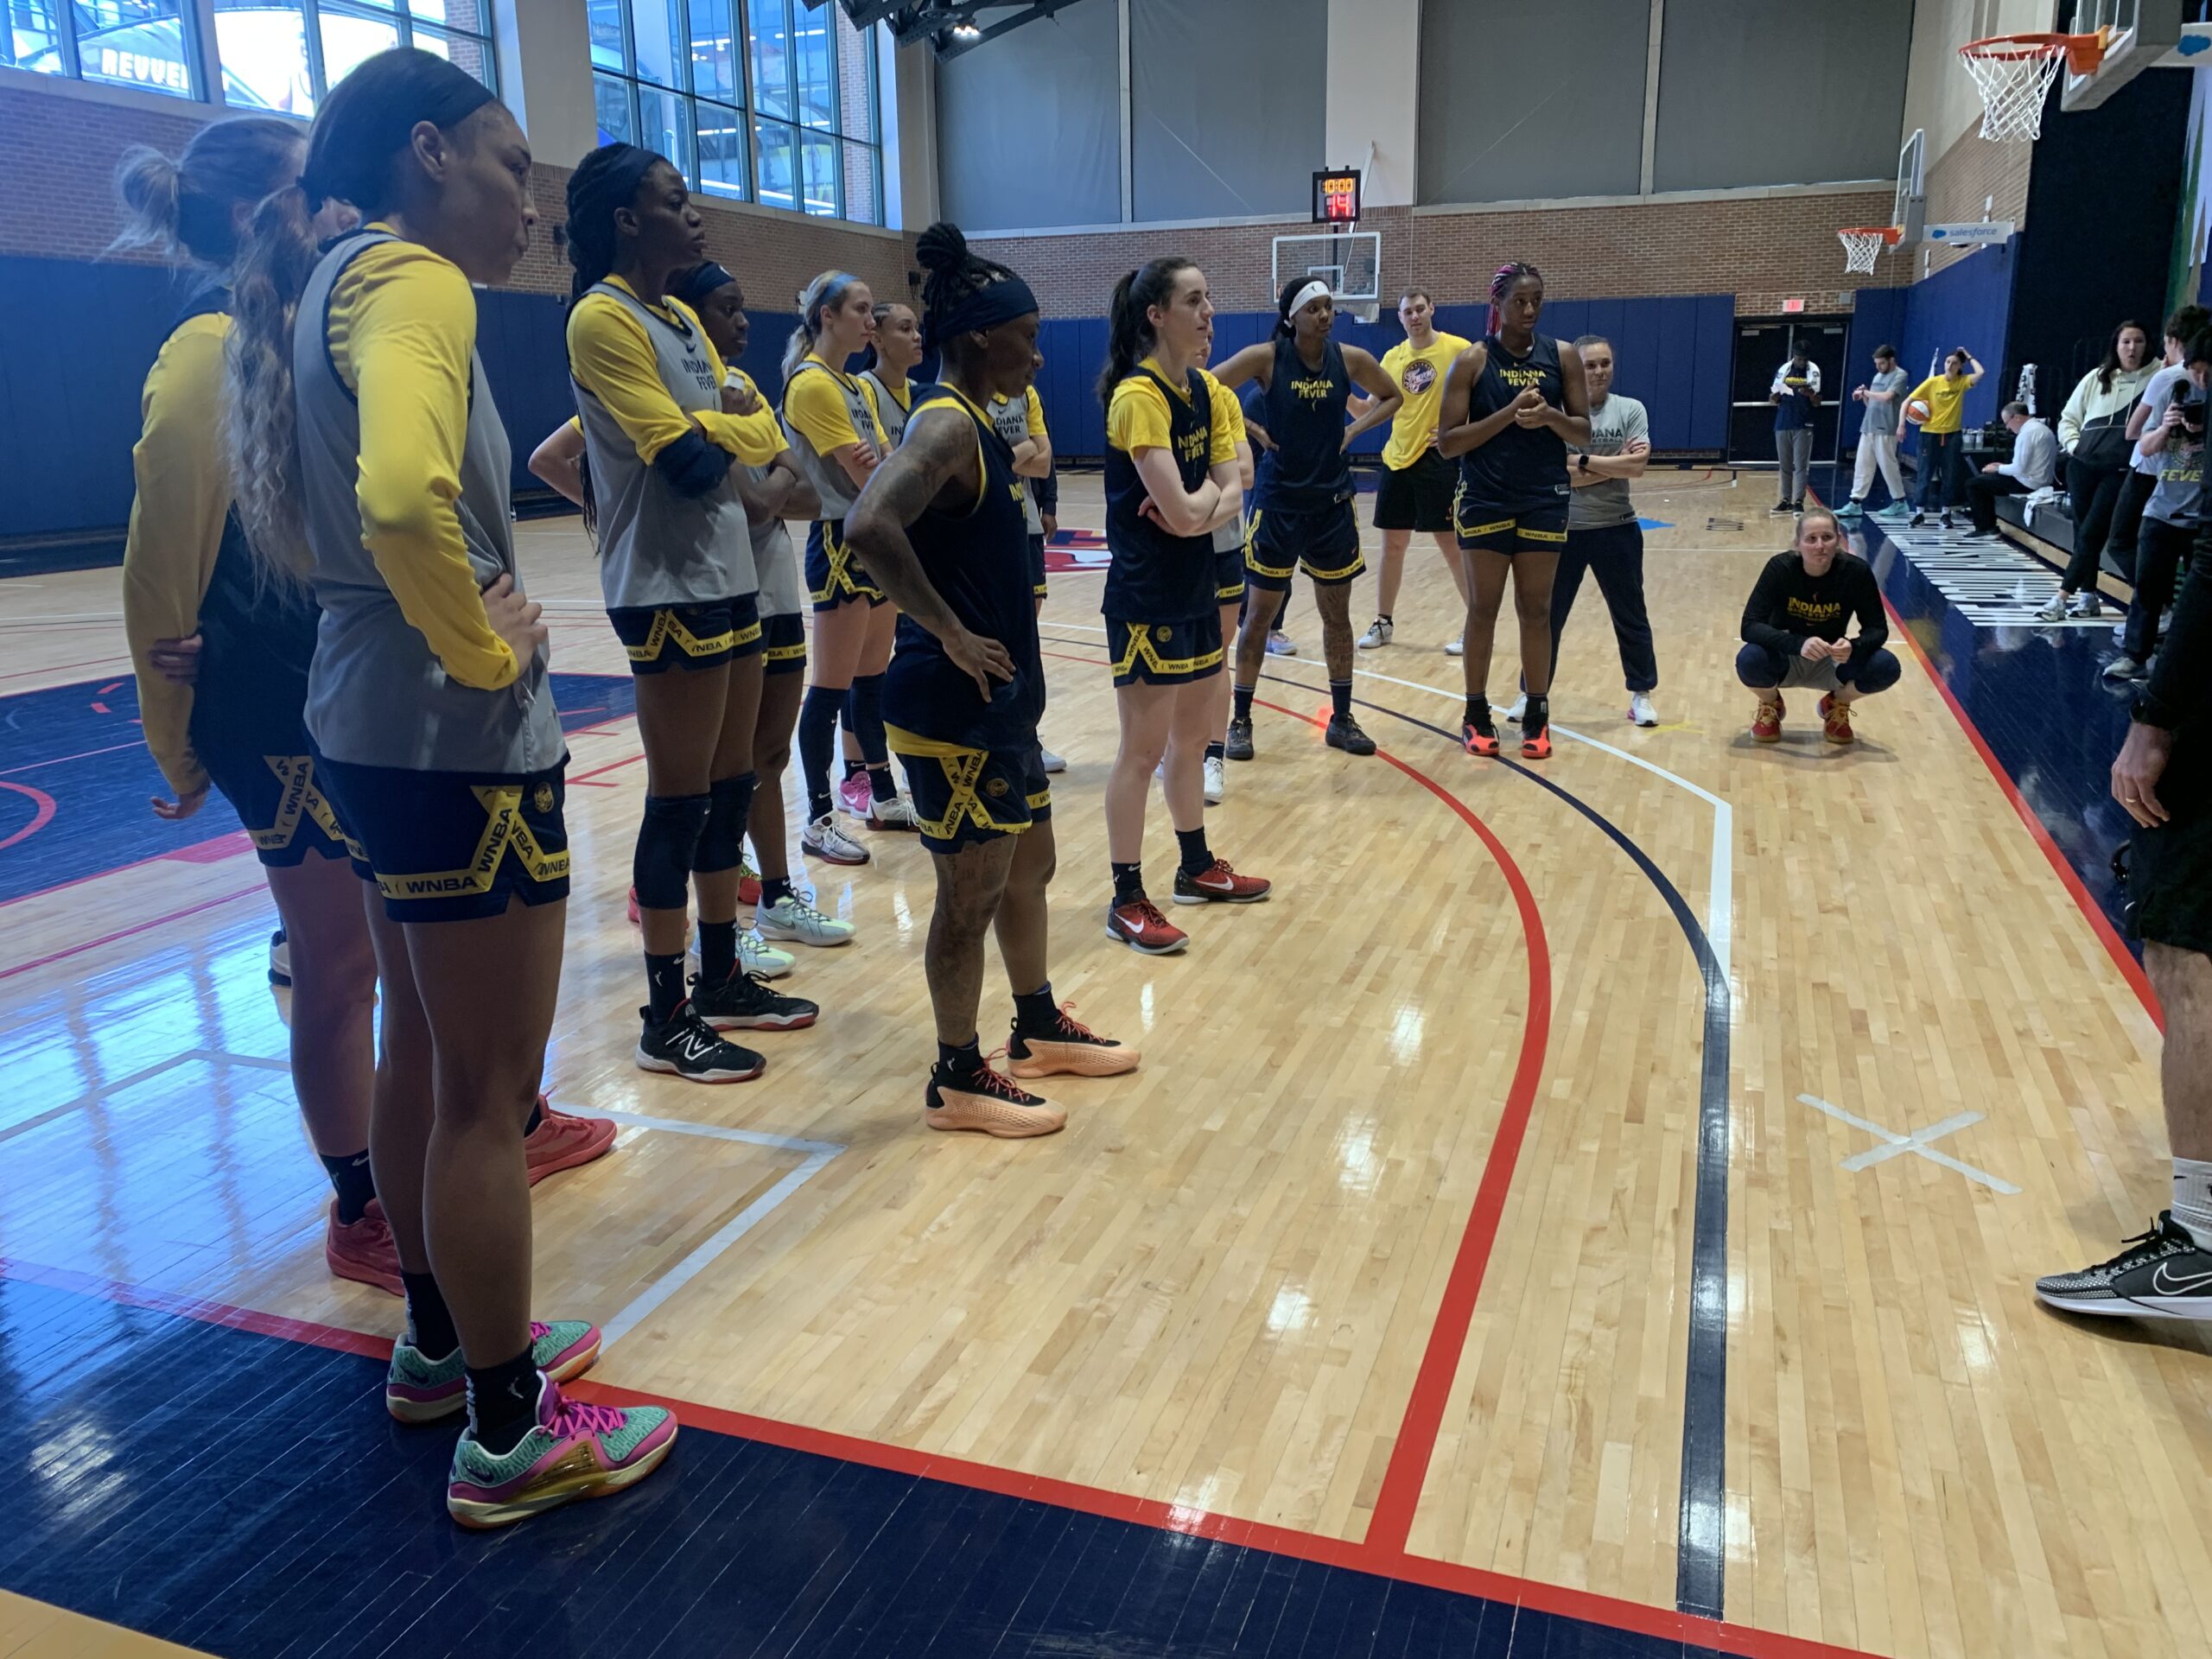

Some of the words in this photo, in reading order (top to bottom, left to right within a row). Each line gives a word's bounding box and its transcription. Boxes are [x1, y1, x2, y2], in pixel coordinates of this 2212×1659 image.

[1332, 194, 1350, 217] 14
[1949, 227, 1998, 238] salesforce
[1500, 369, 1547, 378] INDIANA
[1291, 379, 1333, 390] INDIANA
[1299, 389, 1327, 398] FEVER
[1592, 429, 1624, 437] IANA
[2159, 469, 2203, 482] FEVE
[1789, 597, 1840, 613] INDIANA
[651, 608, 668, 647] WNBA
[668, 620, 683, 639] BA
[1127, 629, 1143, 658] WNBA
[963, 750, 984, 787] WNBA
[283, 762, 309, 816] WNBA
[478, 808, 513, 873] WNBA
[406, 875, 479, 894] WNBA
